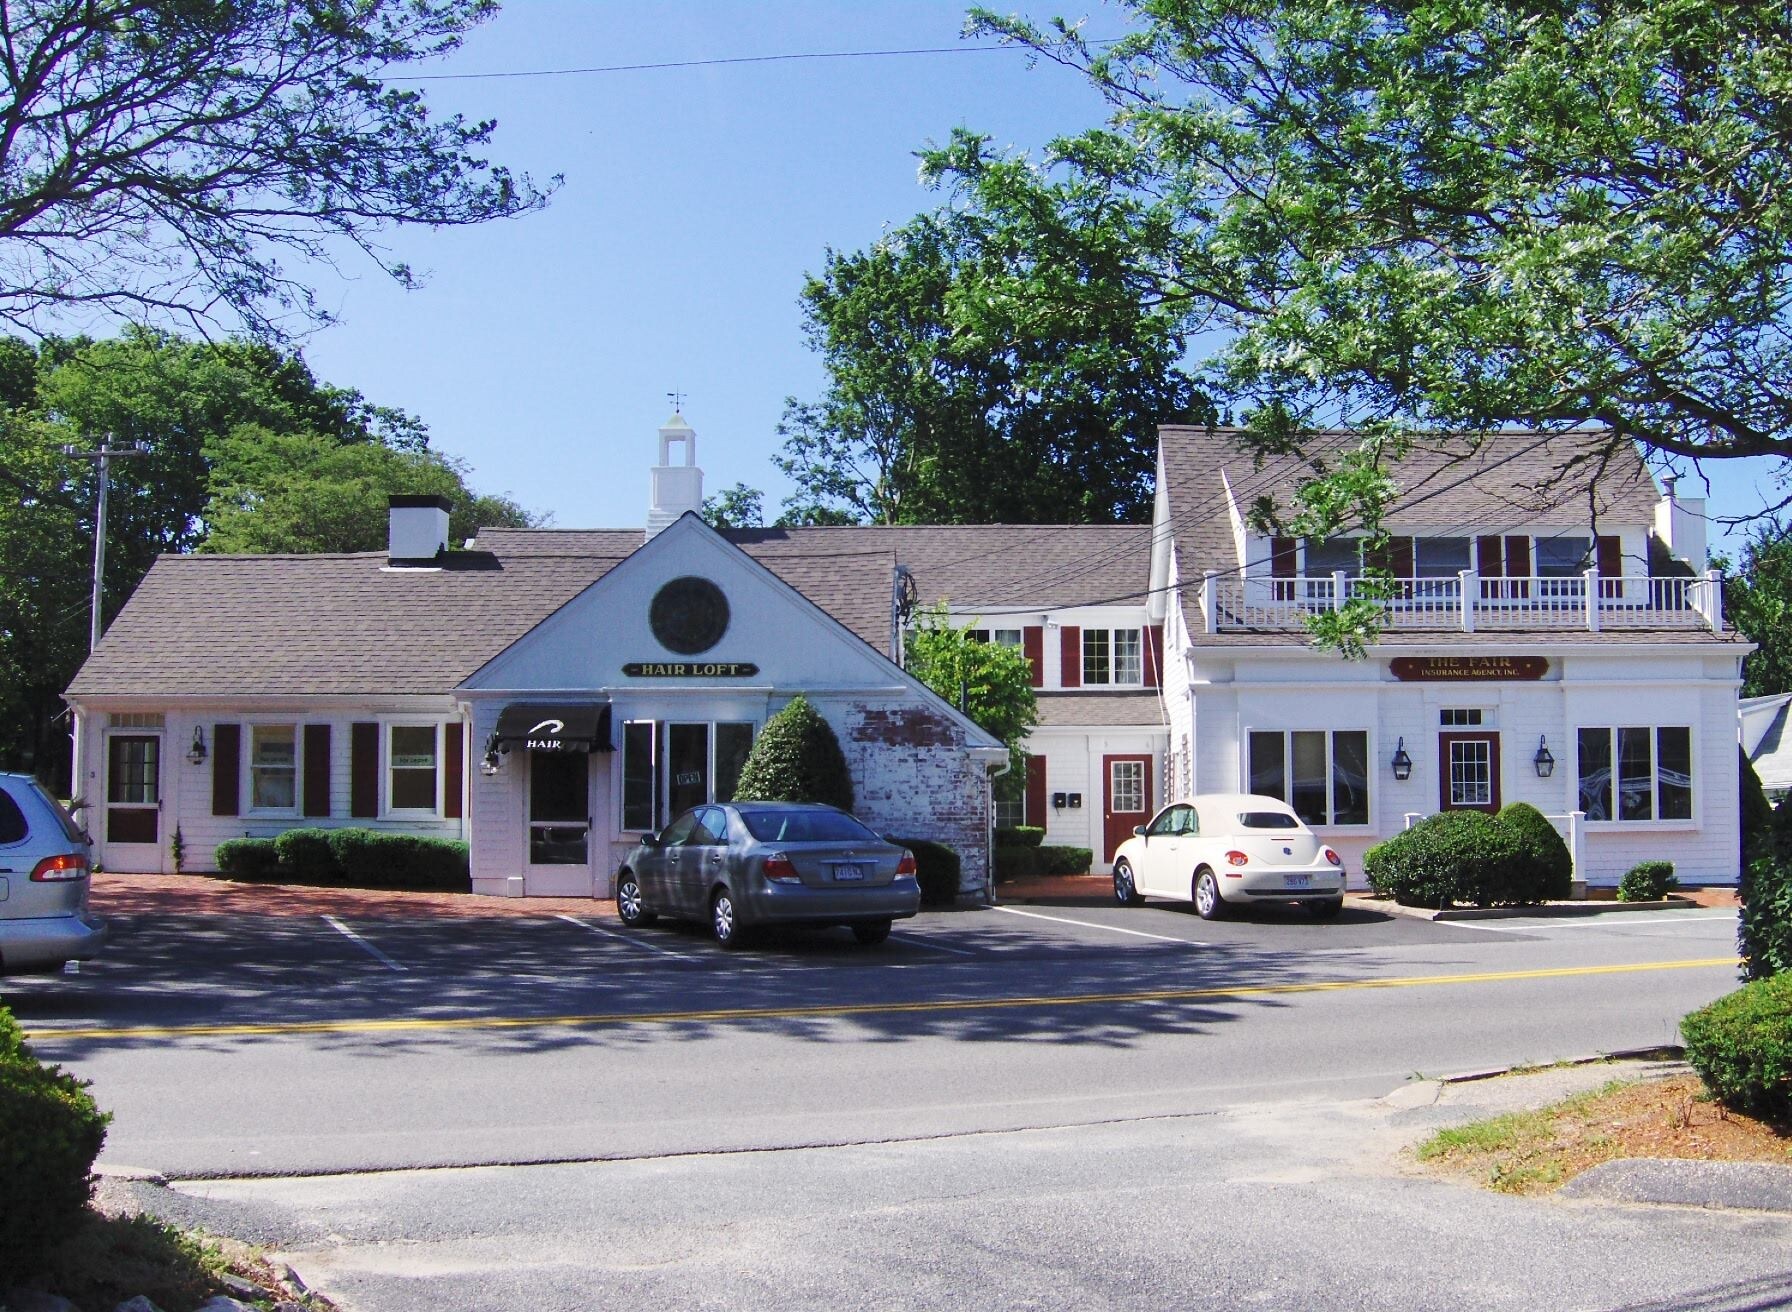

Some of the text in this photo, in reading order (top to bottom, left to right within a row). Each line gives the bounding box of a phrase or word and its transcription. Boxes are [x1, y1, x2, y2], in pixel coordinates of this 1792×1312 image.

[1428, 656, 1512, 667] THE FAIR
[641, 664, 738, 675] HAIR LOFT
[526, 740, 561, 748] HAIR
